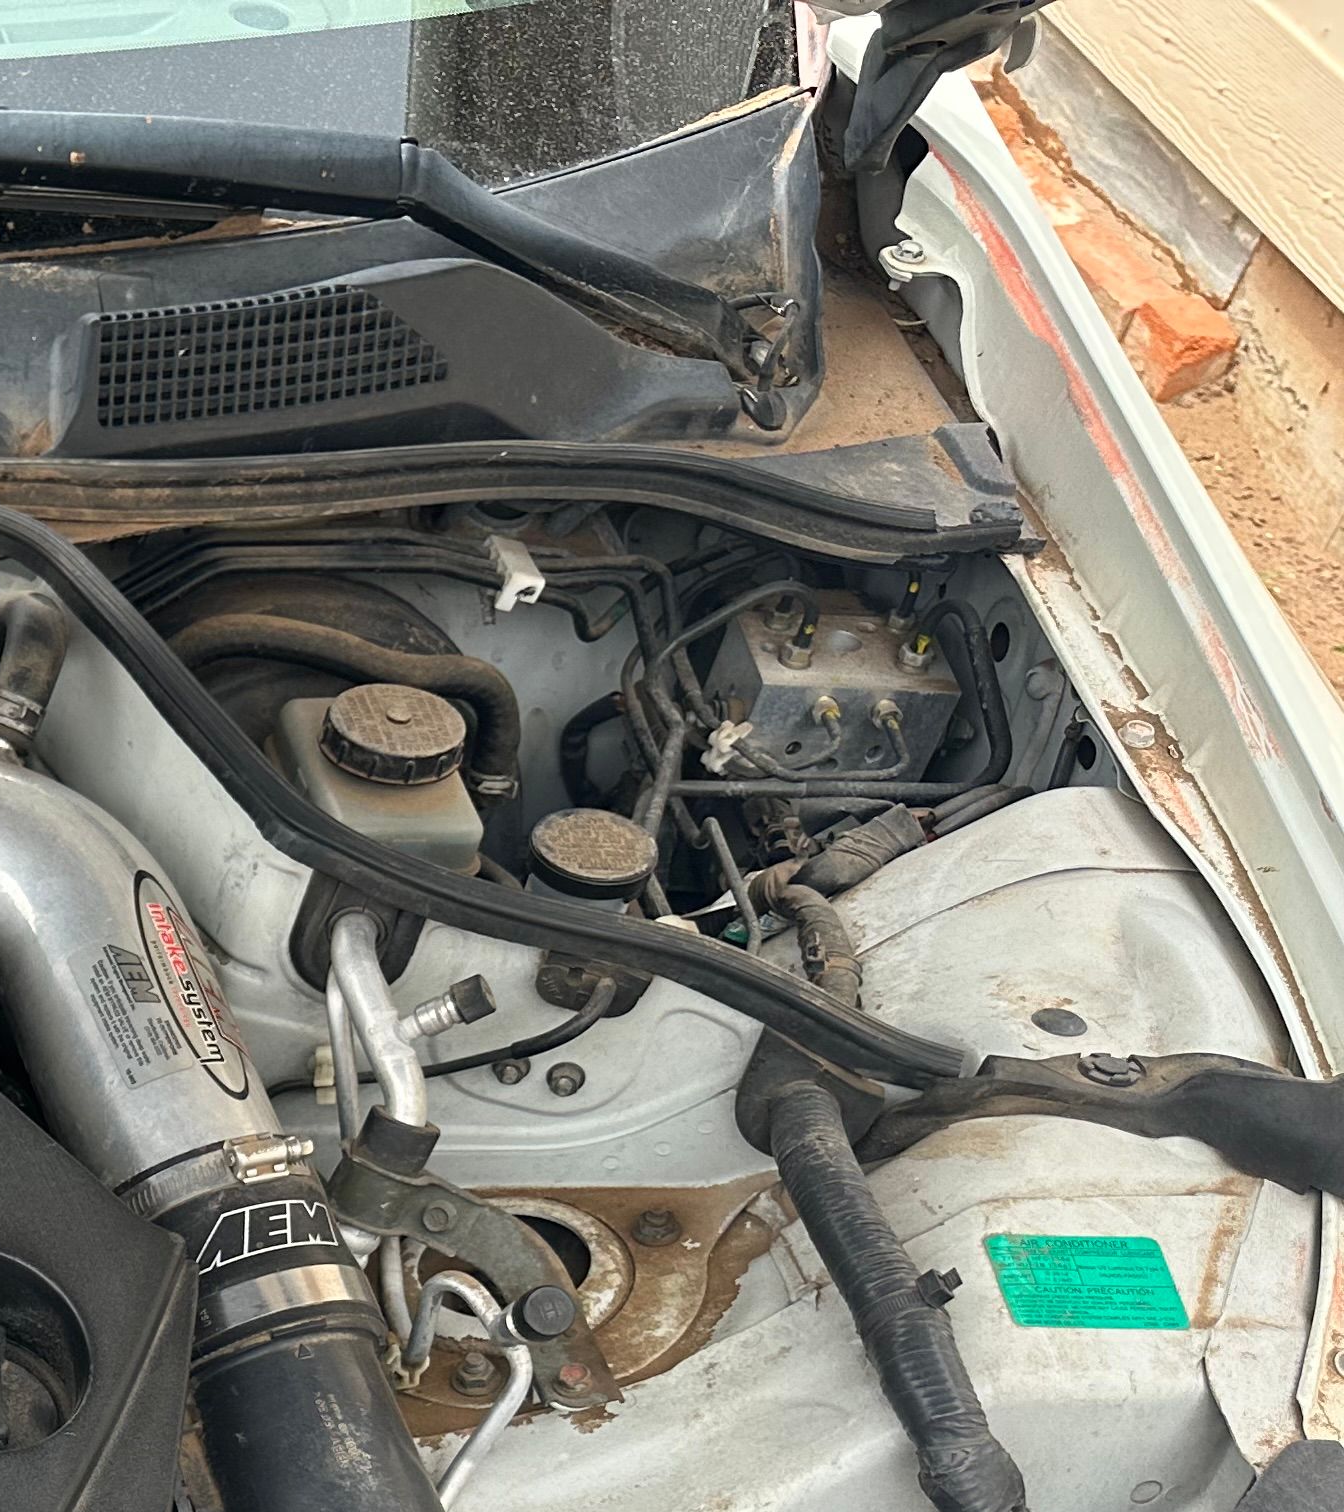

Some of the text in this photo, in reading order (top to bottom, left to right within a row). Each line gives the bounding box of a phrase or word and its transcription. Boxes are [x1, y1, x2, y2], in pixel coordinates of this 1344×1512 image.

[108, 943, 162, 1003] AEM
[146, 902, 189, 977] intake
[179, 978, 226, 1066] system
[196, 1197, 339, 1275] AEM
[1020, 1239, 1128, 1249] AIR CONDITIONER
[1034, 1285, 1082, 1295] CAUTION
